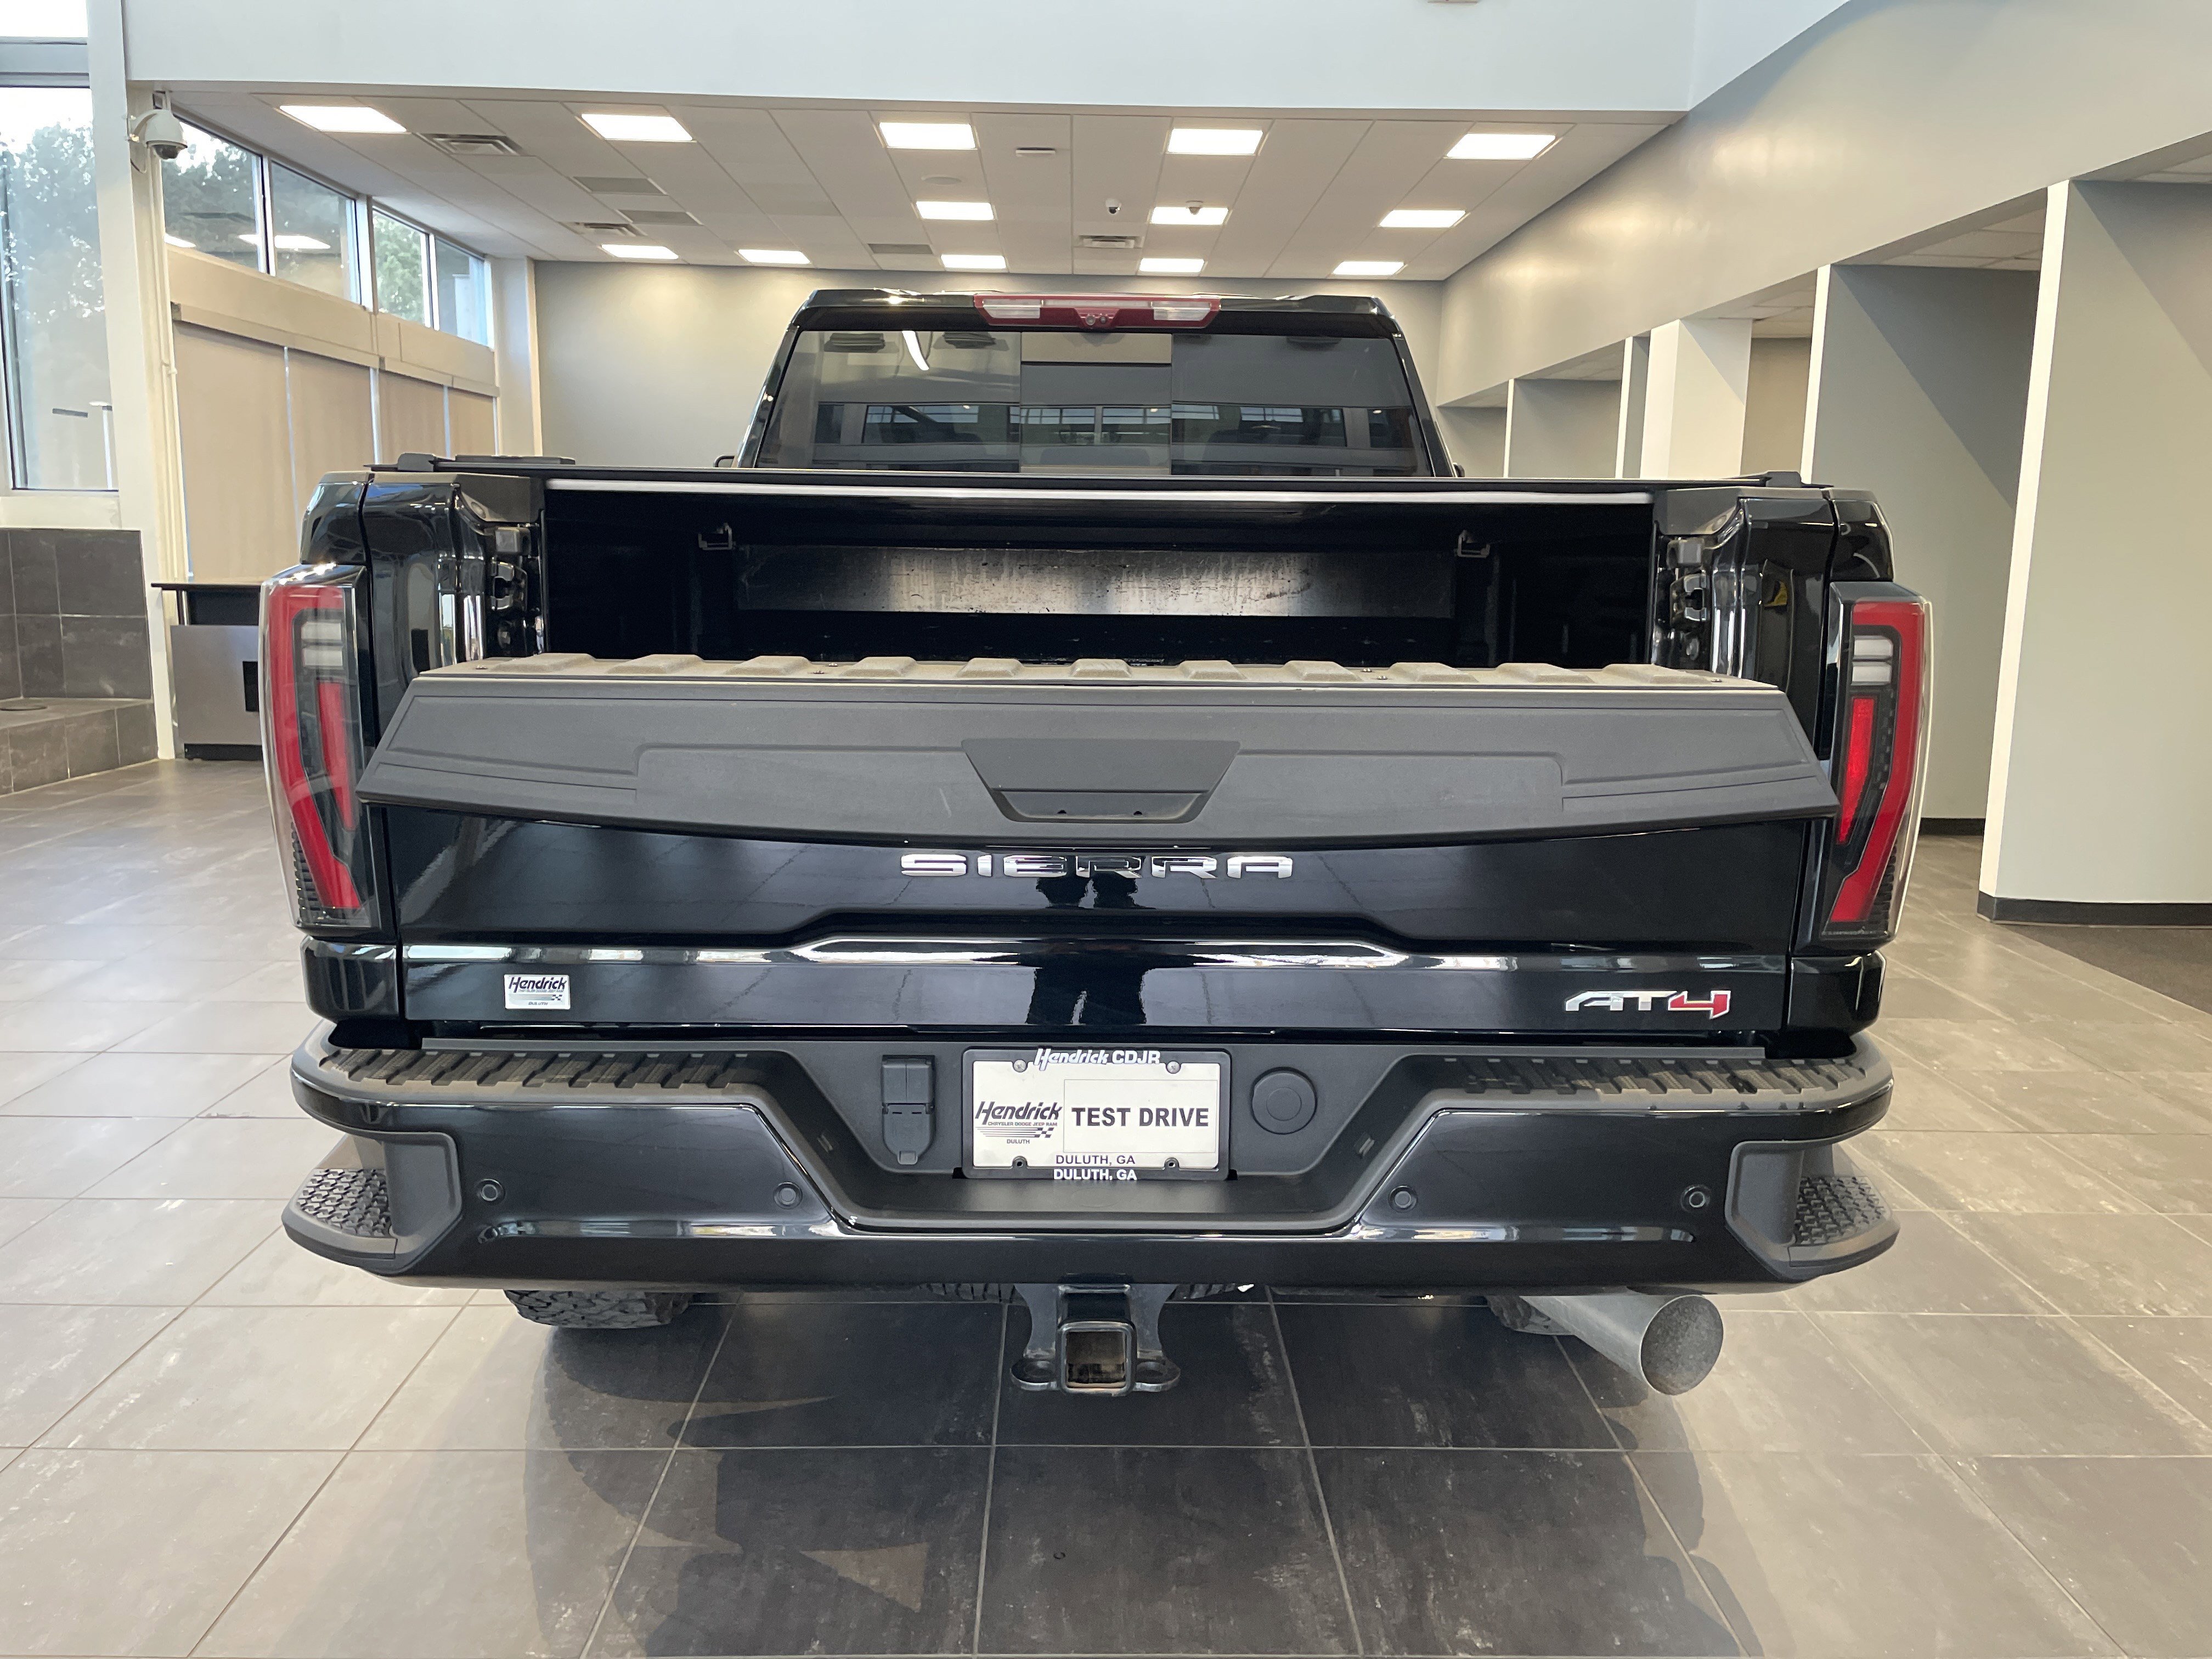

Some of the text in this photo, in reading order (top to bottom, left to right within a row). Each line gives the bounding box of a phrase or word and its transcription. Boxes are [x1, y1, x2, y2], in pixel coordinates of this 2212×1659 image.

[900, 854, 1293, 878] SIERRA
[508, 977, 567, 993] Hendrick
[1565, 990, 1731, 1019] AT4
[1034, 1048, 1161, 1071] Hendrick CDJR
[974, 1101, 1063, 1125] Hendrick
[1071, 1107, 1209, 1127] TEST DRIVE
[1056, 1155, 1136, 1166] DULUTH, GA
[1053, 1169, 1137, 1181] DULUTH, GA
